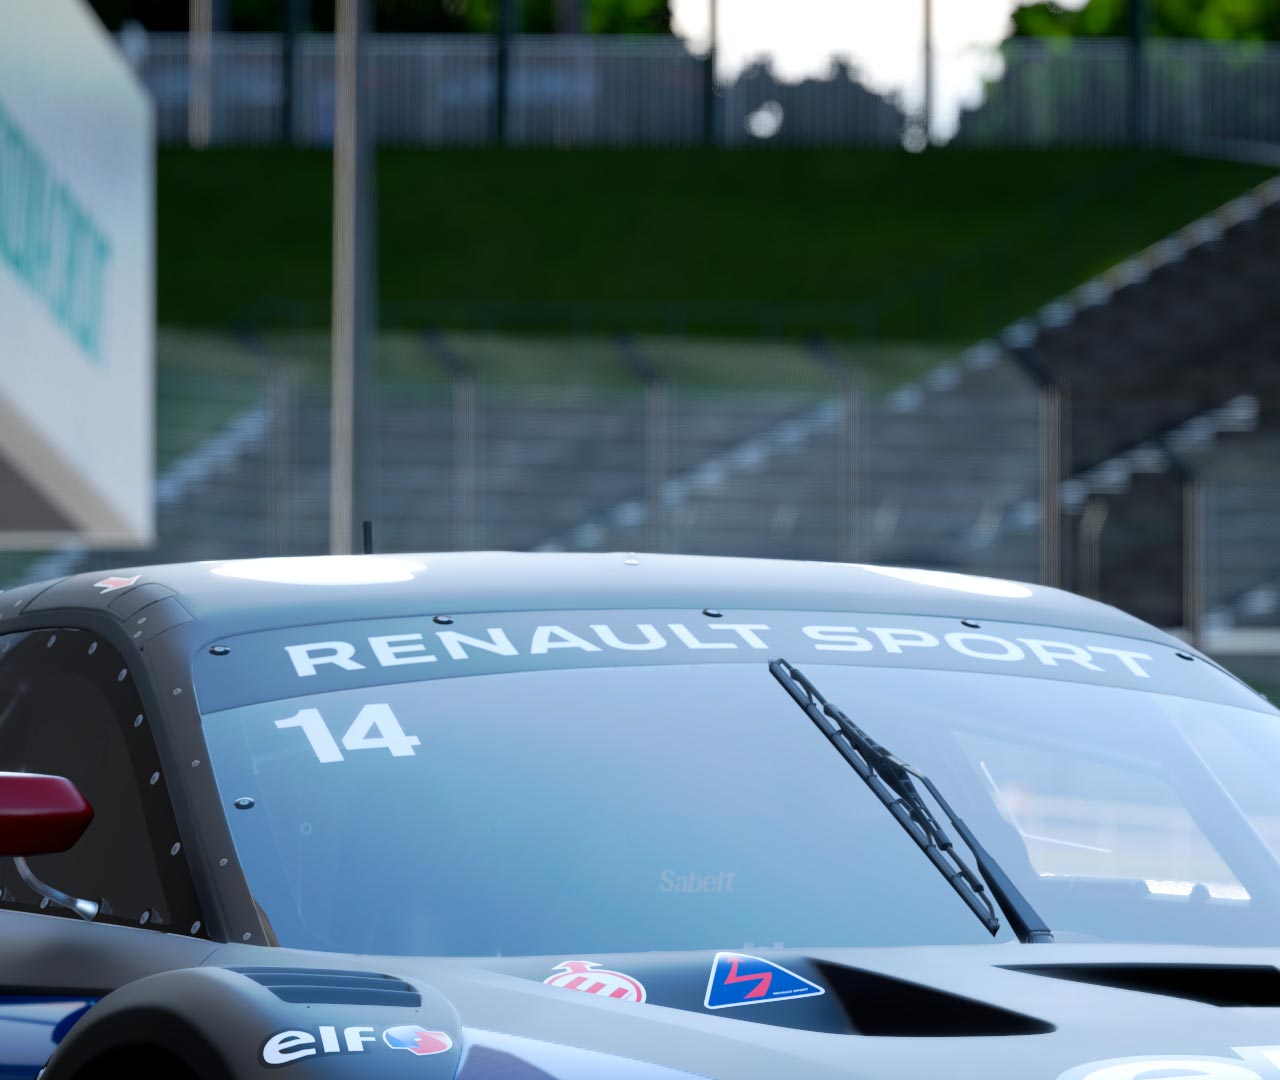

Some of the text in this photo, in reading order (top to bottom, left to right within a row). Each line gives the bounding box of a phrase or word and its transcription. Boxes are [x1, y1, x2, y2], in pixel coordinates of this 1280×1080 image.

[285, 623, 1154, 679] RENAULT SPORT
[275, 702, 422, 763] 14
[262, 1024, 377, 1065] elf
